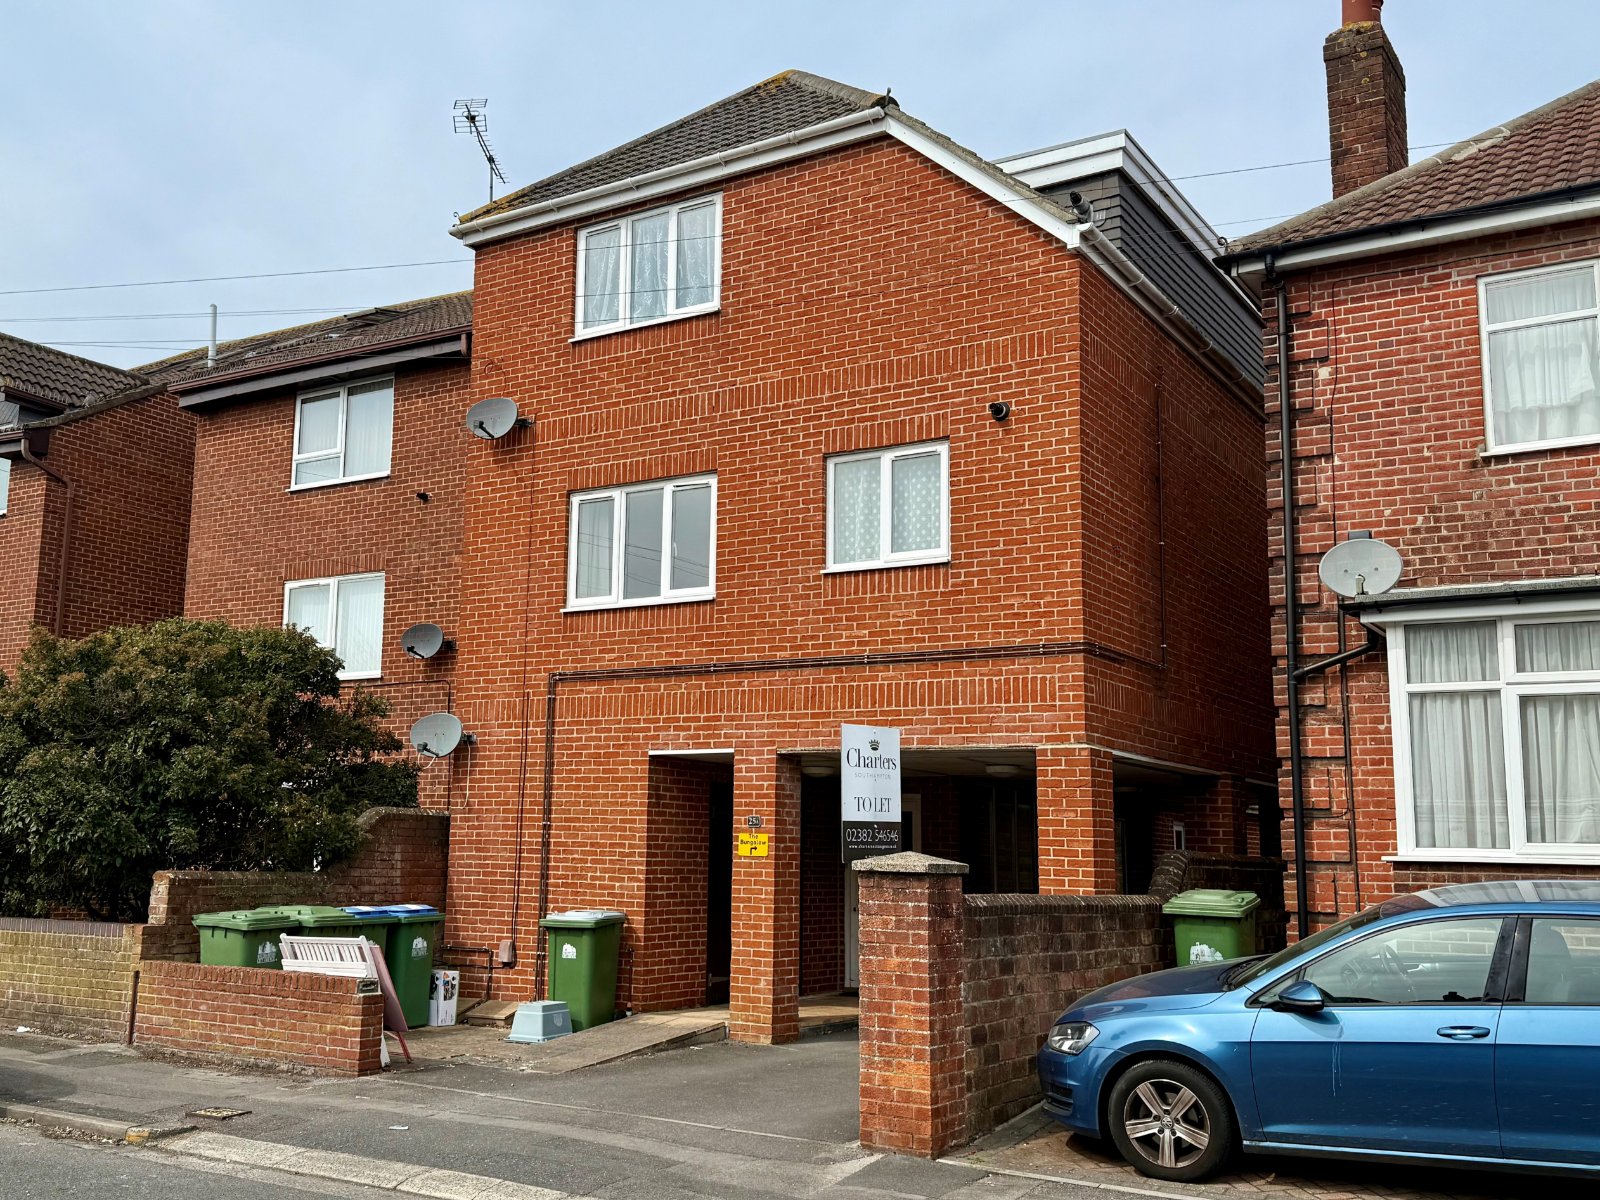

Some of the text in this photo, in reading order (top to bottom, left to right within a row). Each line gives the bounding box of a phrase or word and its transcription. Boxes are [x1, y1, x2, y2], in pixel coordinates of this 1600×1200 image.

[846, 747, 897, 771] Charters
[854, 796, 892, 813] TO LET
[845, 828, 899, 842] 02382 546546
